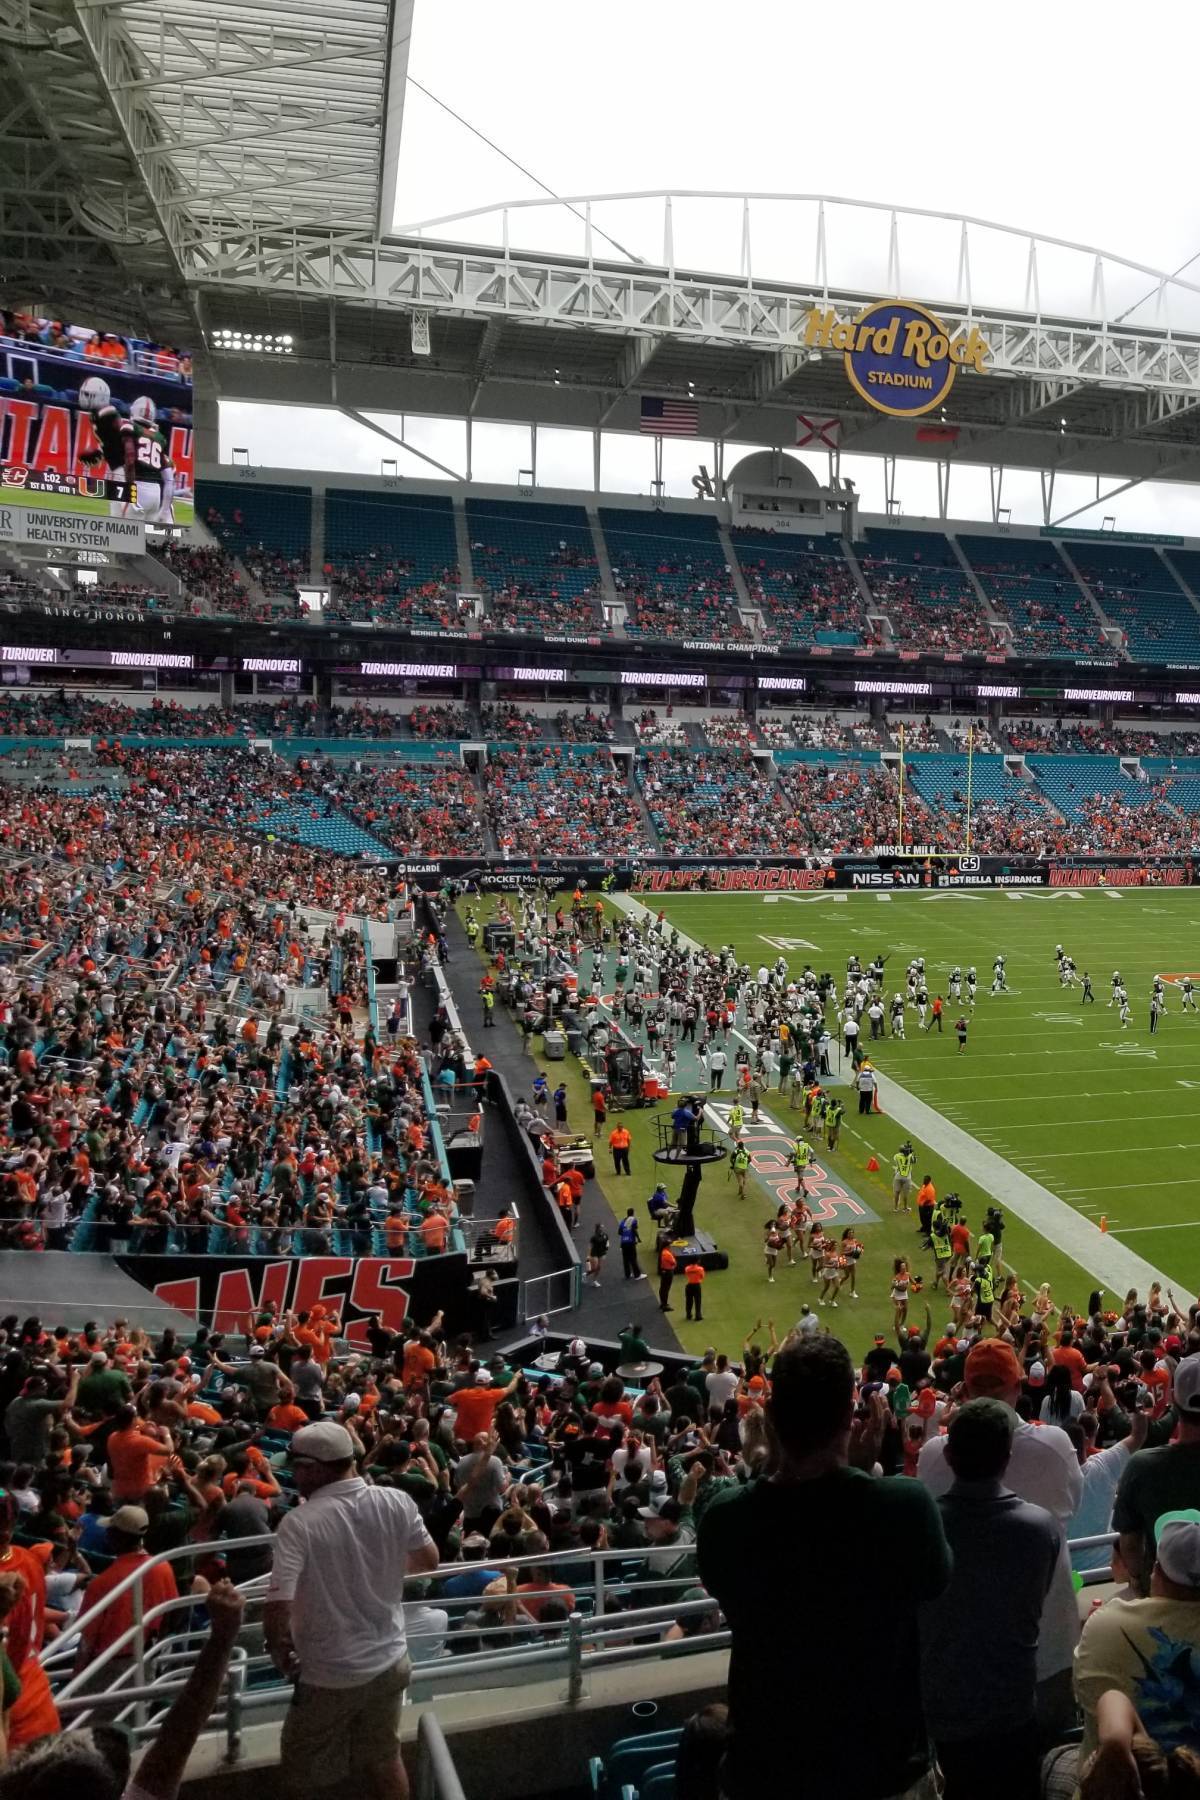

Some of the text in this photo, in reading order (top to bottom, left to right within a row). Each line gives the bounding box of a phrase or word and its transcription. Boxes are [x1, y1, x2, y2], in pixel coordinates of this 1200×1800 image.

[805, 308, 989, 373] Hard Rock
[868, 371, 932, 389] STADIUM
[138, 437, 162, 469] 26
[44, 472, 61, 484] 1:02
[239, 469, 256, 478] 356
[117, 487, 123, 499] 7
[27, 513, 88, 531] UNIVERSITY
[90, 521, 103, 532] OF
[106, 522, 139, 536] MIAMI
[27, 528, 67, 543] HEALTH
[70, 531, 109, 547] SYSTEM
[45, 607, 145, 622] RING HONOR
[683, 641, 779, 653] NATIONAL CHAMPIONS
[2, 647, 54, 661] TURNOVER
[243, 659, 298, 672] TURNOVER
[513, 668, 563, 681] TURNOVER
[758, 677, 803, 690] TURNOVER
[977, 686, 1018, 697] TURNOVER
[874, 845, 937, 856] MUSCLE MILK
[407, 863, 440, 872] BACARDÍ
[962, 857, 977, 869] 25
[708, 869, 825, 891] HURRICANES
[853, 873, 919, 884] NISSAN
[950, 875, 1042, 884] ESTRELLA INSURANCE
[1104, 868, 1194, 887] HURRCANE
